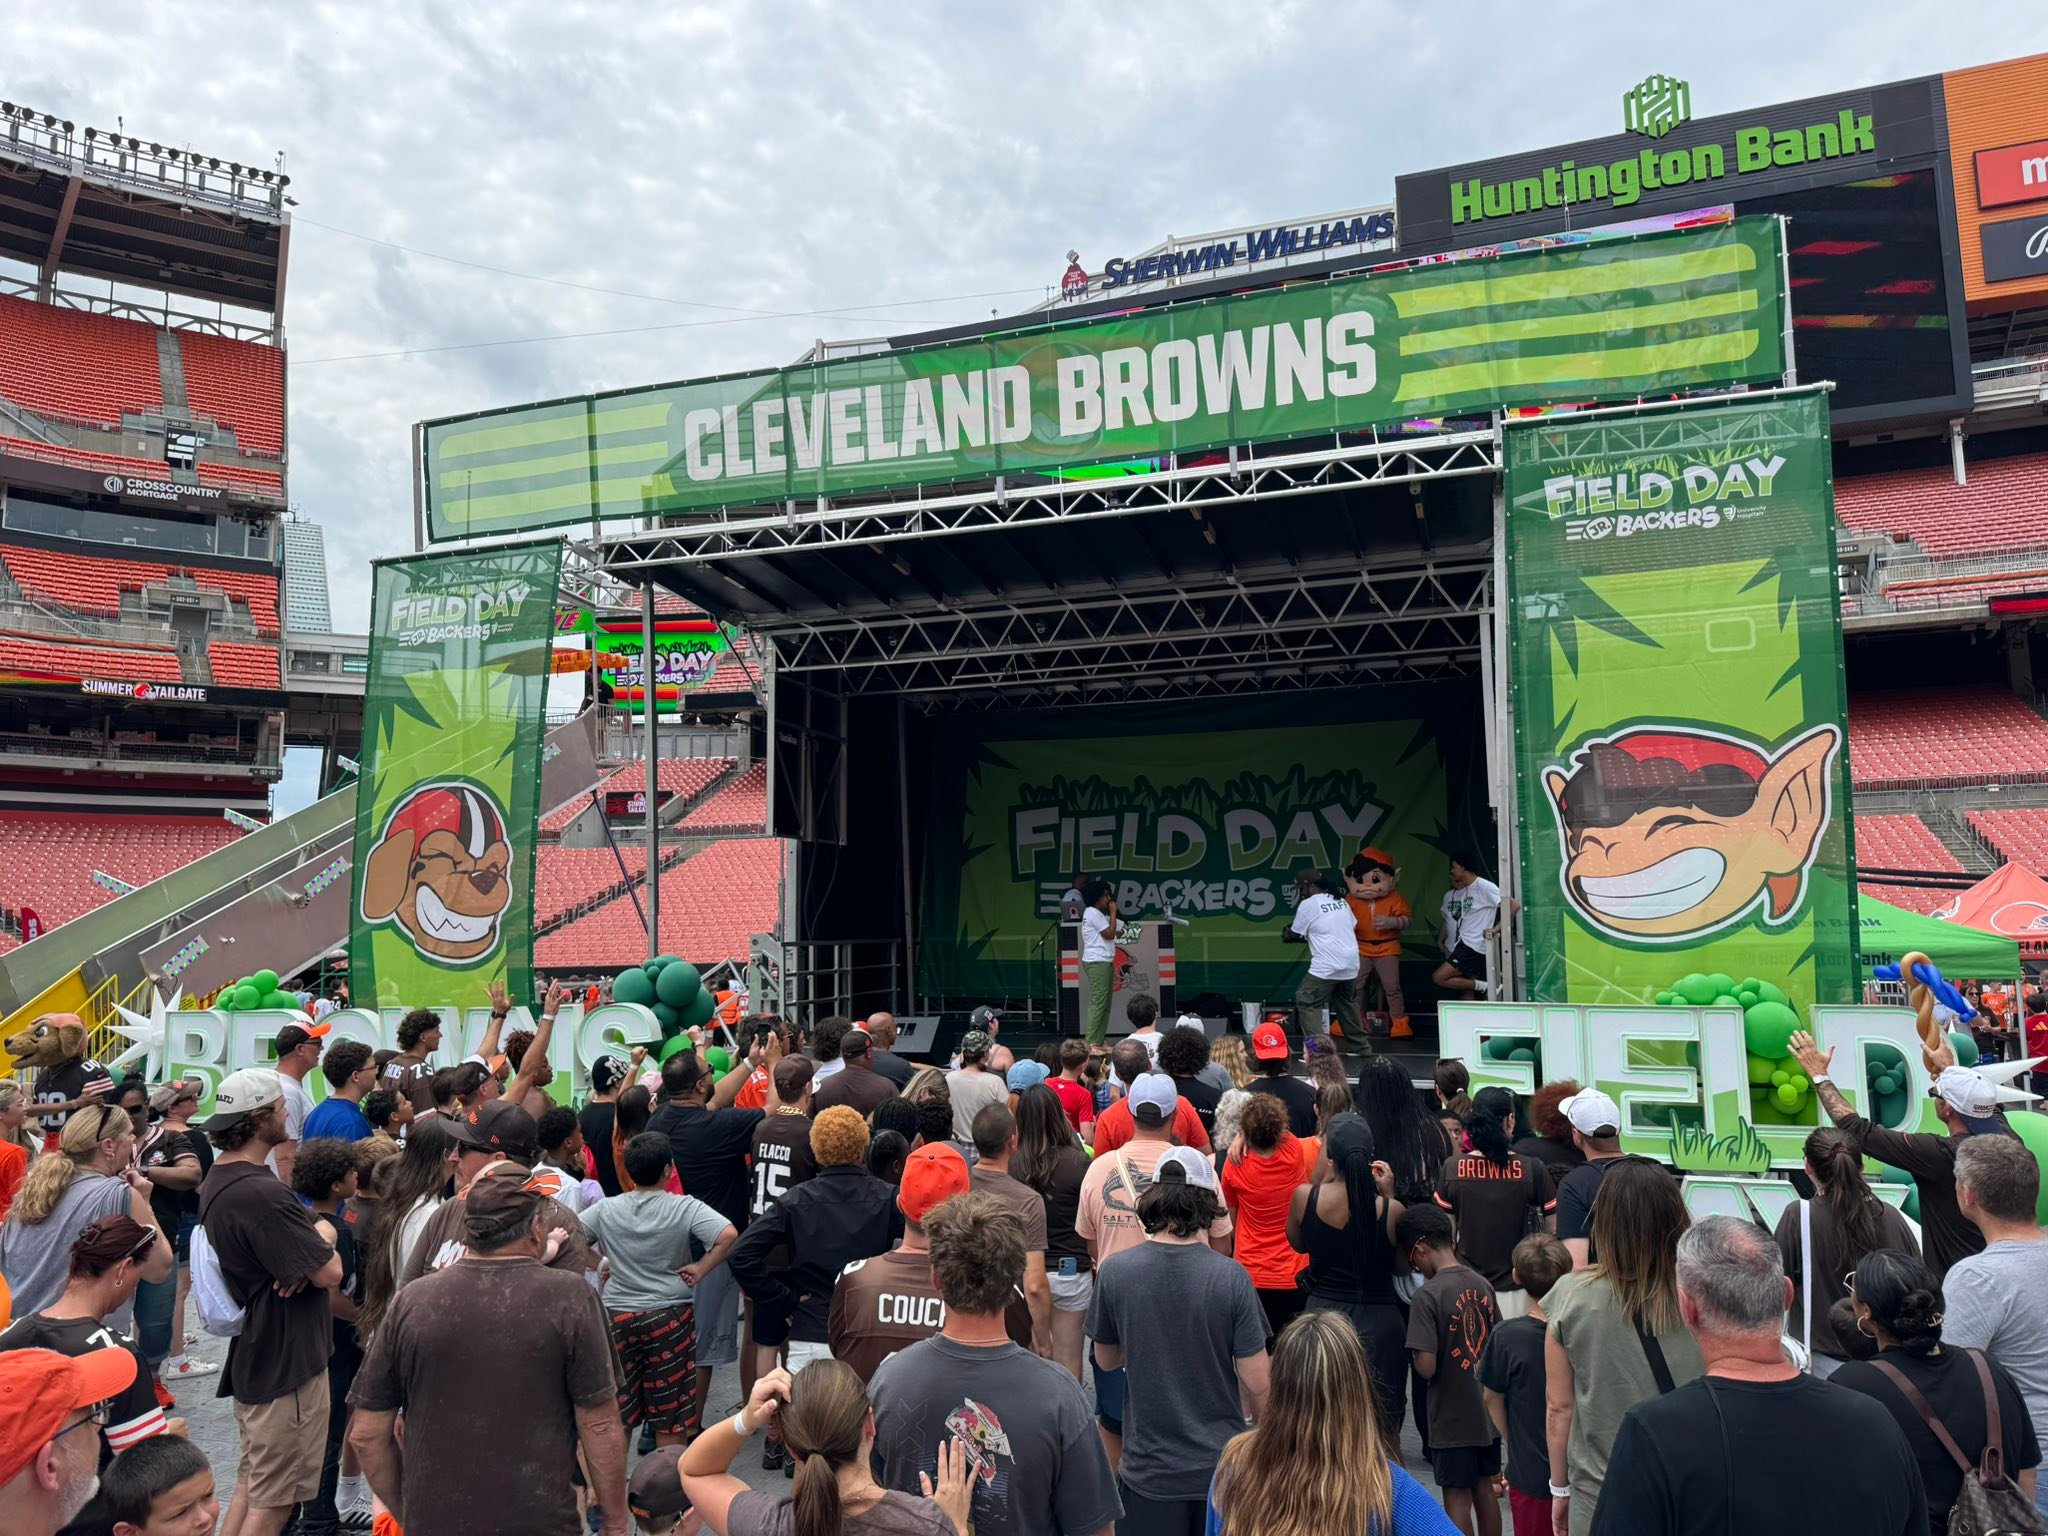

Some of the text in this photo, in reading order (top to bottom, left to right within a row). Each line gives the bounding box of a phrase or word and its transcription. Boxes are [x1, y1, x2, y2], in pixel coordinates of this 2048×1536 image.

[1450, 109, 1875, 224] Huntington Bank
[1101, 211, 1395, 290] SHERWIN-WILLIAMS
[684, 310, 1377, 481] CLEVELAND BROWNS
[126, 478, 221, 499] CROSSCOUNTRY
[126, 487, 179, 501] MORTGAGE
[1543, 455, 1787, 521] FIELD DAY
[1617, 505, 1720, 536] BACKERS
[391, 596, 467, 632] FIELD
[475, 586, 531, 621] DAY
[426, 623, 491, 644] BACKERS
[82, 680, 206, 701] SUMMER TAILGATE
[1016, 802, 1384, 874] FIELD DAY
[1117, 879, 1276, 916] BACKERS
[1437, 1001, 1950, 1178] FIELD
[758, 1142, 791, 1162] FLACCO
[1457, 1158, 1522, 1179] BROWNS
[752, 1161, 791, 1215] 15
[1103, 1215, 1134, 1223] SALT
